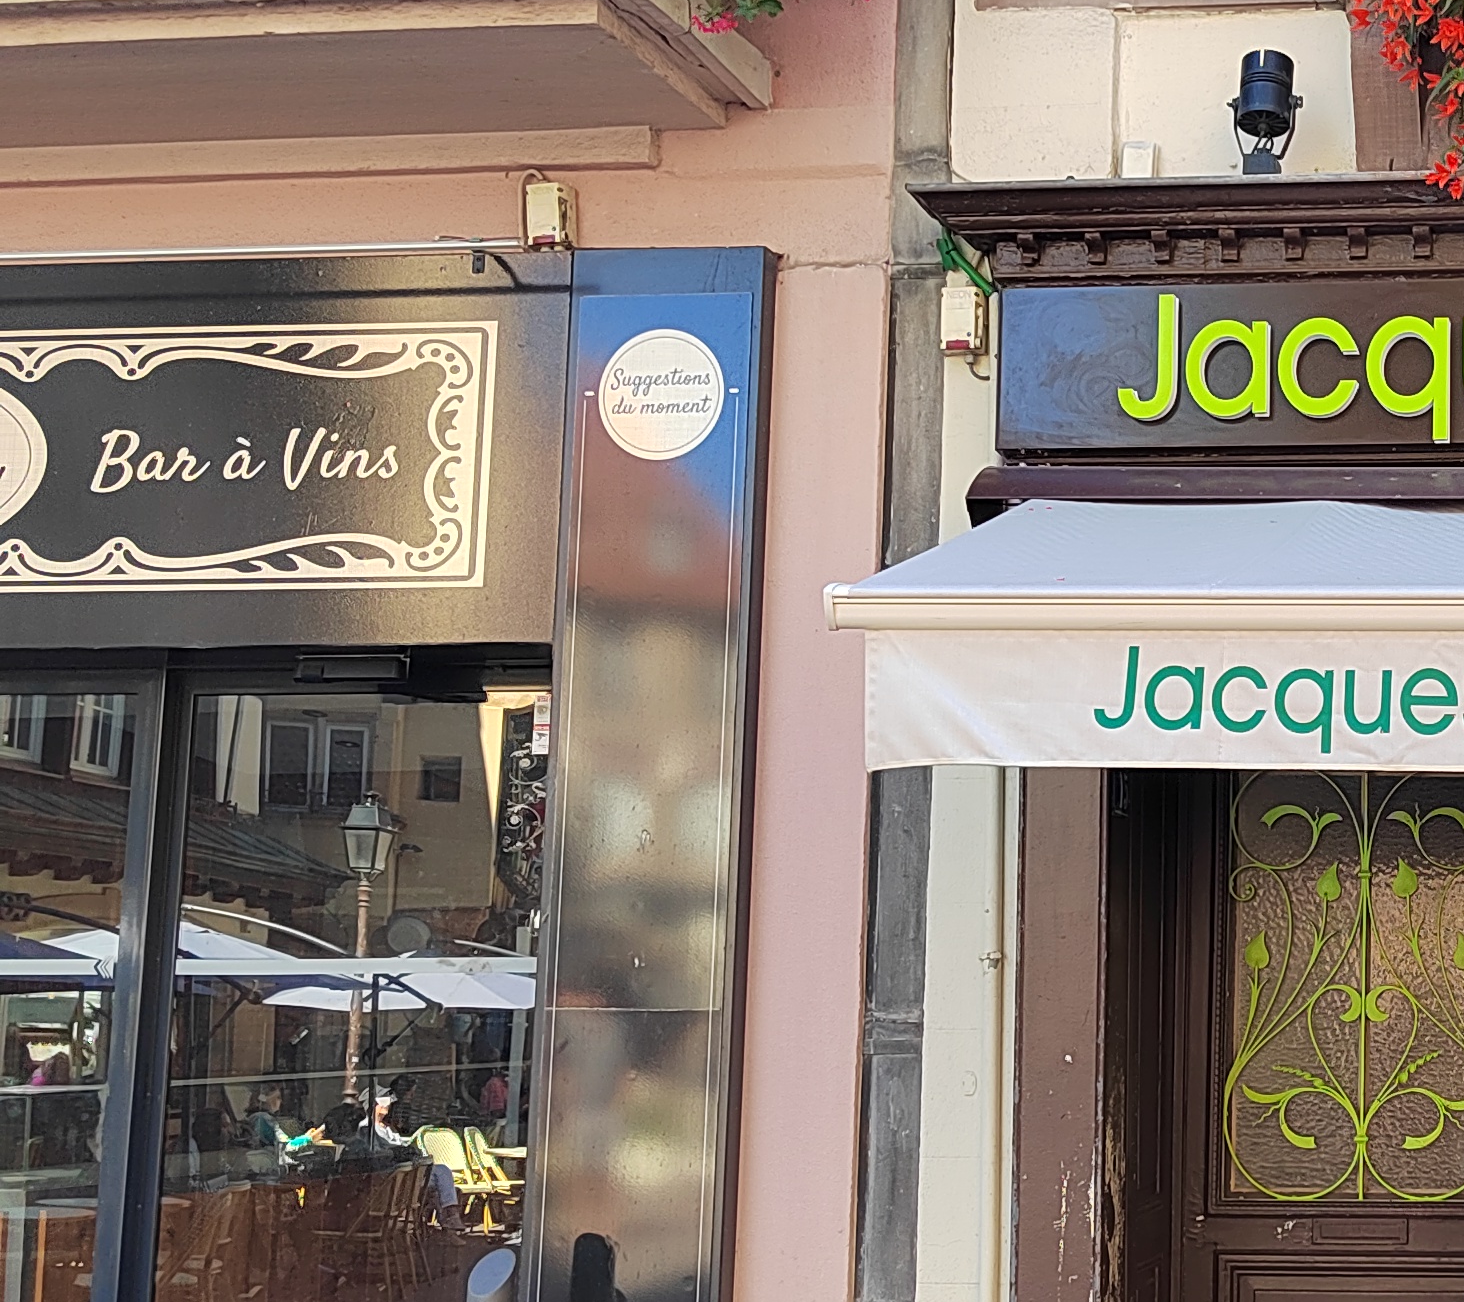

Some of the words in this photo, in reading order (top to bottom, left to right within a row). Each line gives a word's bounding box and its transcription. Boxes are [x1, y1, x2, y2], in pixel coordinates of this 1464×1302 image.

[611, 368, 710, 397] Suggestions
[612, 396, 636, 415] du
[640, 394, 712, 415] moment
[91, 429, 210, 493] Bar
[223, 437, 266, 480] à
[284, 428, 399, 491] Vins
